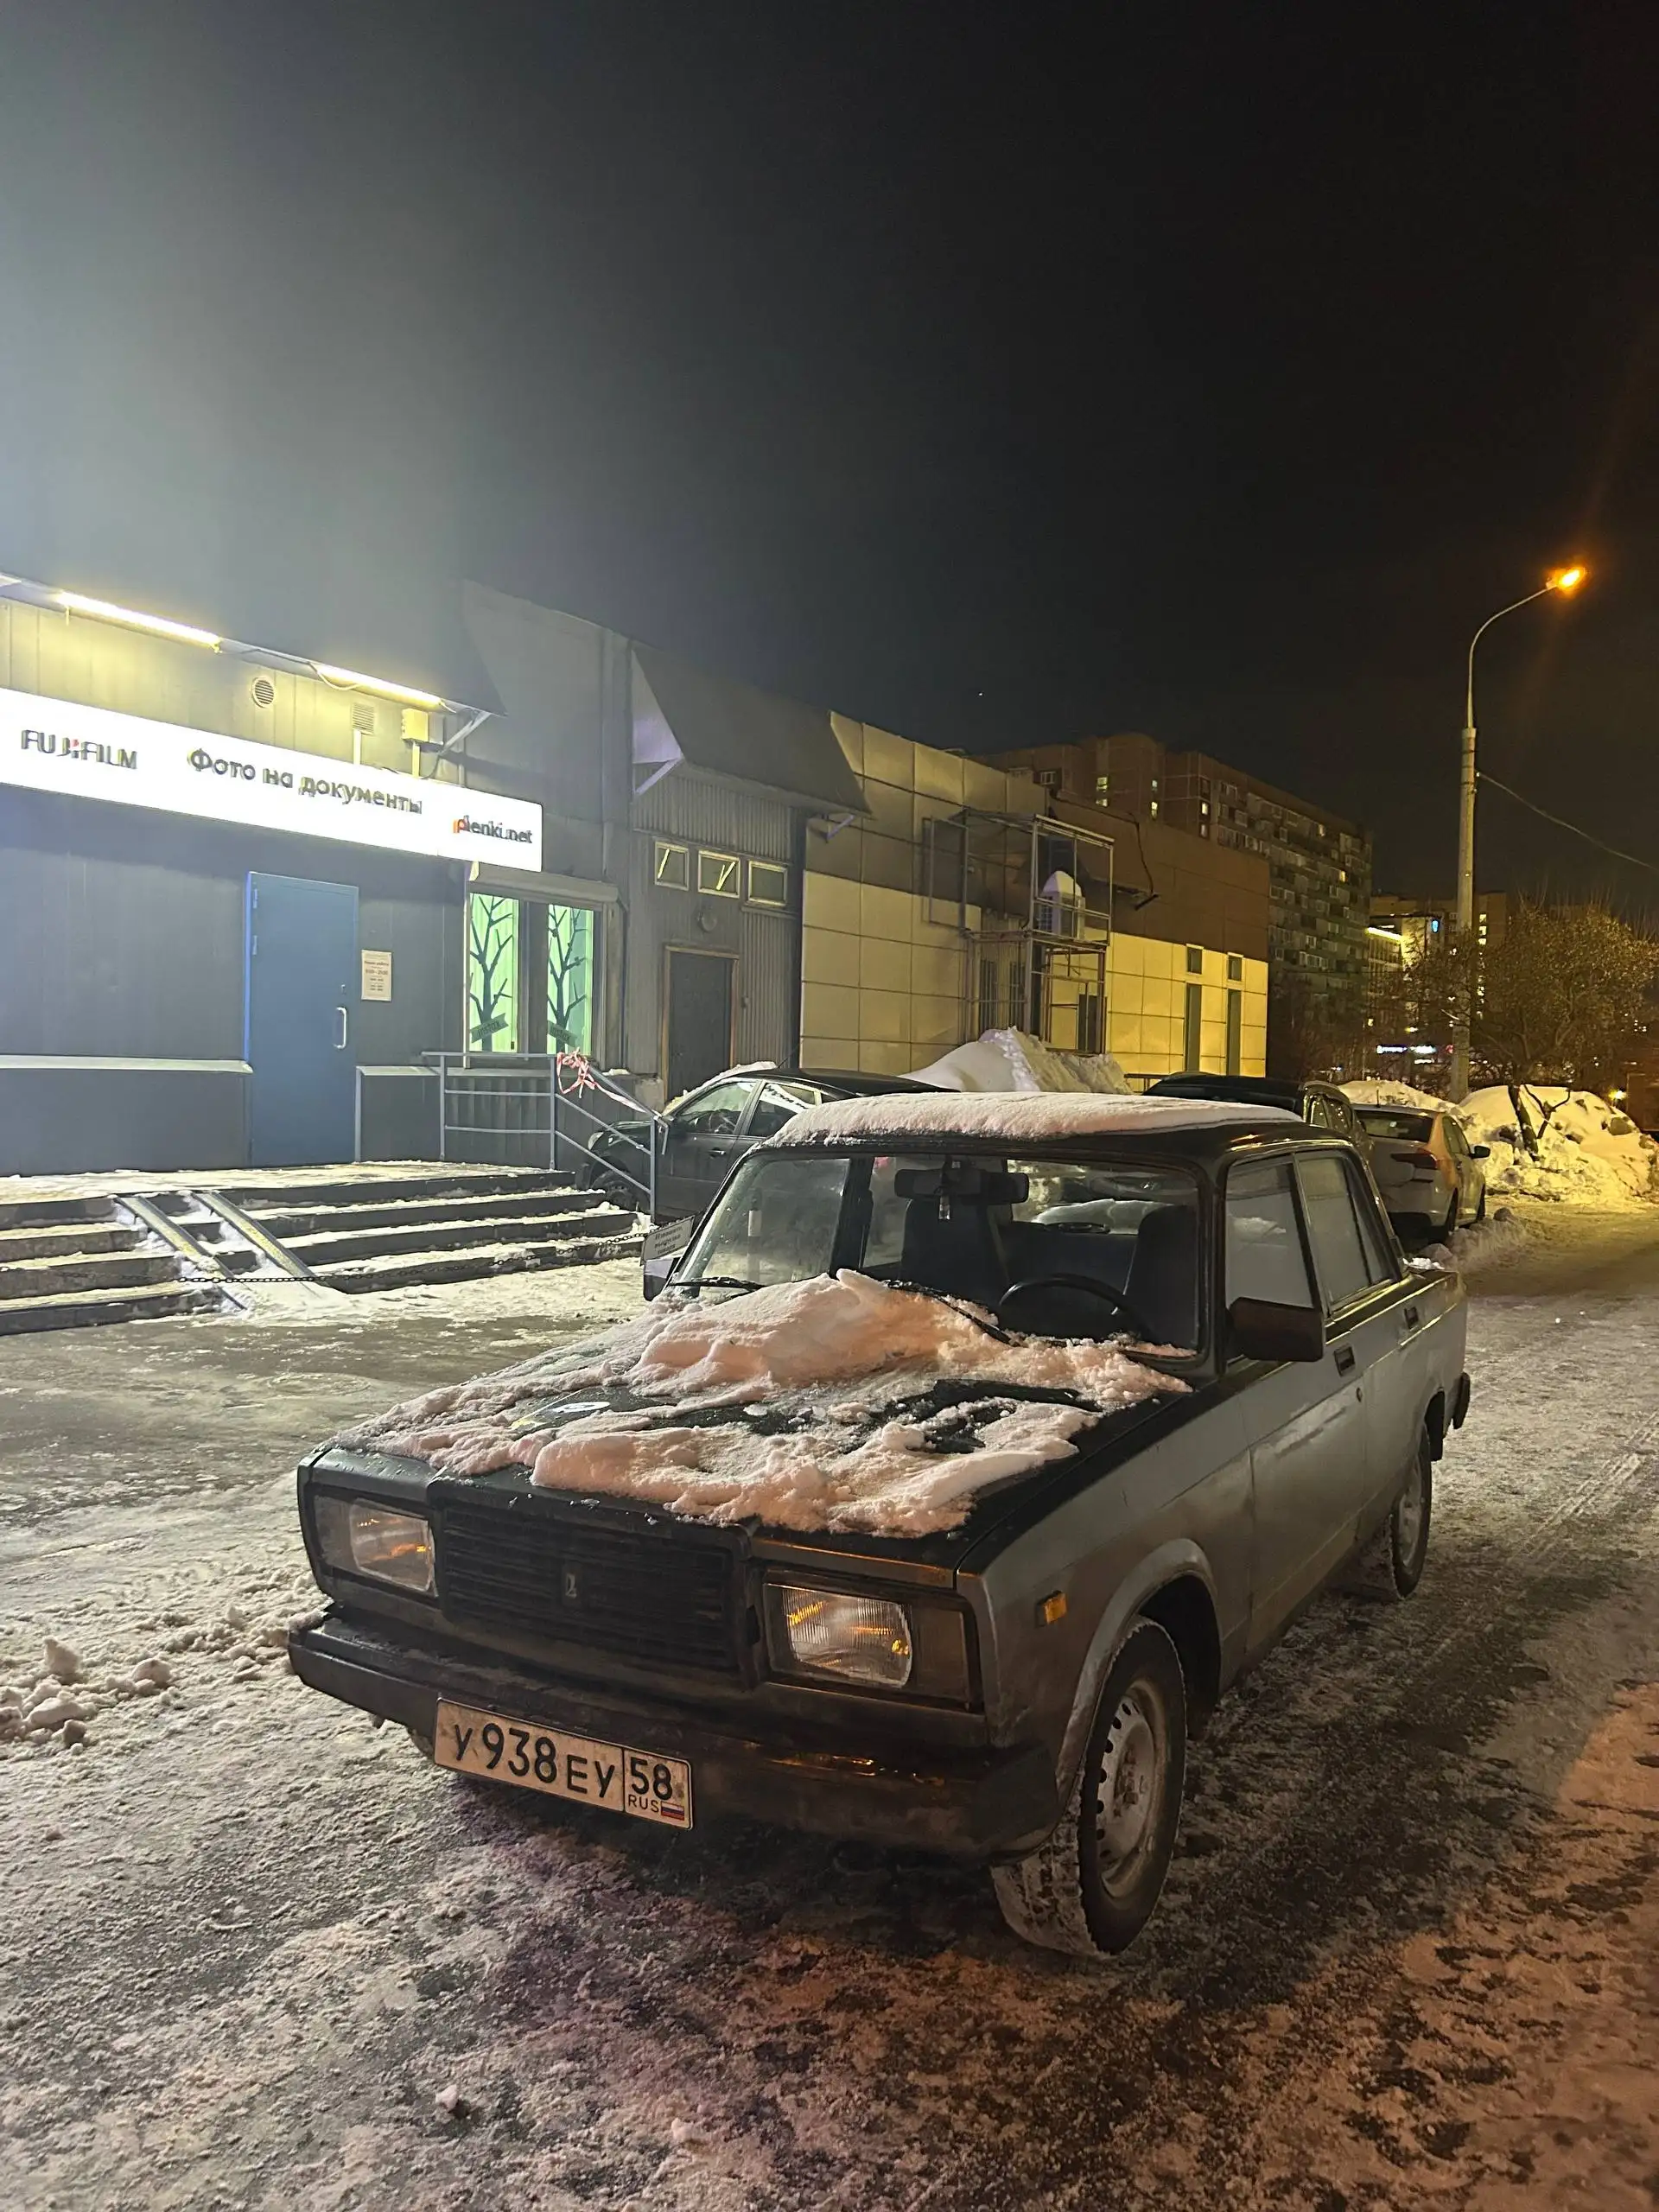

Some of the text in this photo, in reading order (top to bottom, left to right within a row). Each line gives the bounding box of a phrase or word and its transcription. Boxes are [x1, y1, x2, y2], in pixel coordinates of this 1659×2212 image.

[21, 729, 137, 769] FUJIFILM
[188, 747, 423, 814] Фото на документы
[453, 815, 533, 843] plenki.net
[454, 1723, 673, 1801] У938ЕУ 58
[627, 1794, 660, 1814] RUS
